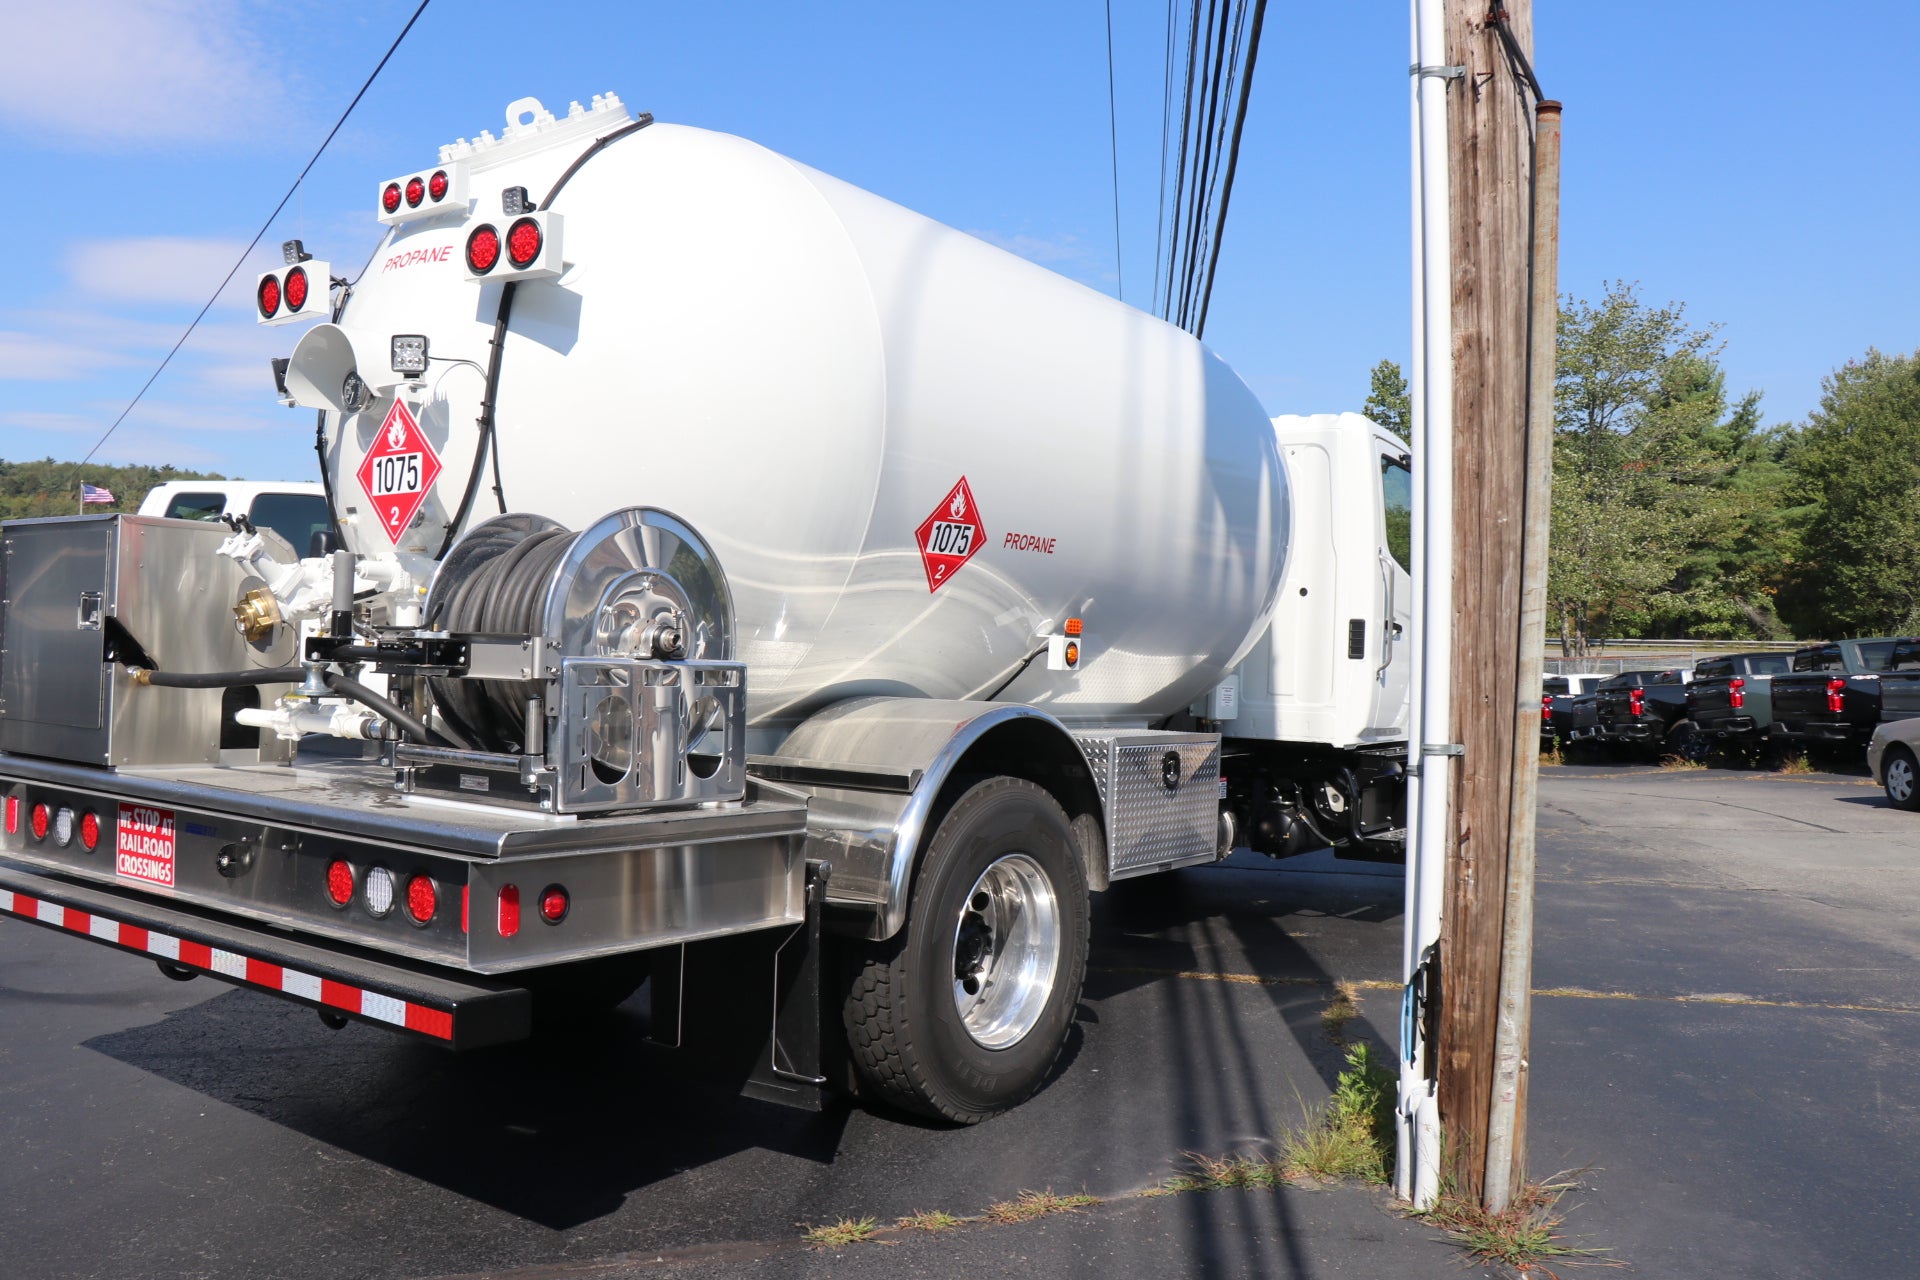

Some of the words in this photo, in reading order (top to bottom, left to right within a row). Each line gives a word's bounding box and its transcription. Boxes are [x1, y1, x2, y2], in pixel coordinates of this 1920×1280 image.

[382, 246, 453, 273] PROPANE
[377, 455, 418, 493] 1075
[390, 506, 400, 526] 2
[932, 523, 971, 554] 1075
[1004, 532, 1056, 554] PROPANE
[935, 564, 946, 579] 2
[120, 810, 132, 829] WE
[134, 808, 160, 833] STOP
[161, 818, 173, 837] AT
[120, 832, 172, 859] RAILROAD
[119, 853, 171, 882] CROSSINGS
